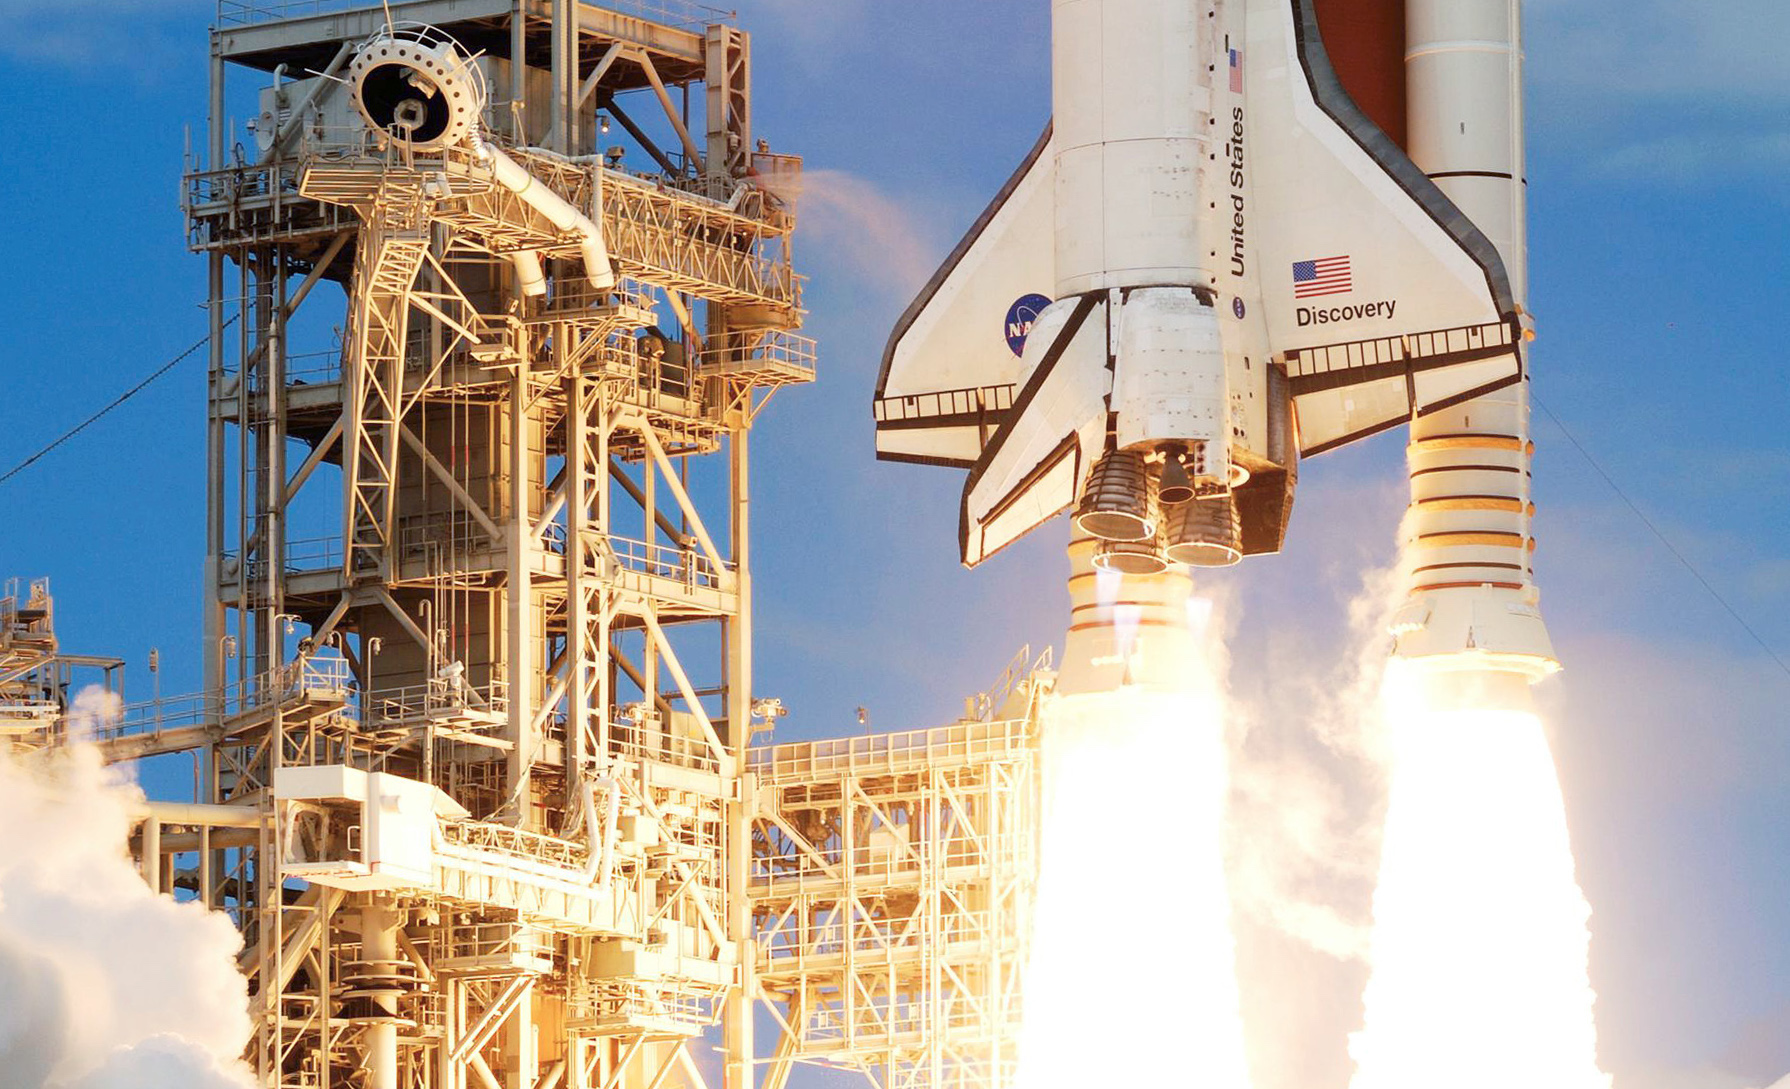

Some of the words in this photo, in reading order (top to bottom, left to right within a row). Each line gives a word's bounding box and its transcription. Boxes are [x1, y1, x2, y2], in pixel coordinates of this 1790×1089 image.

[1230, 107, 1244, 189] States
[1231, 194, 1244, 277] United
[1296, 300, 1396, 327] Discovery
